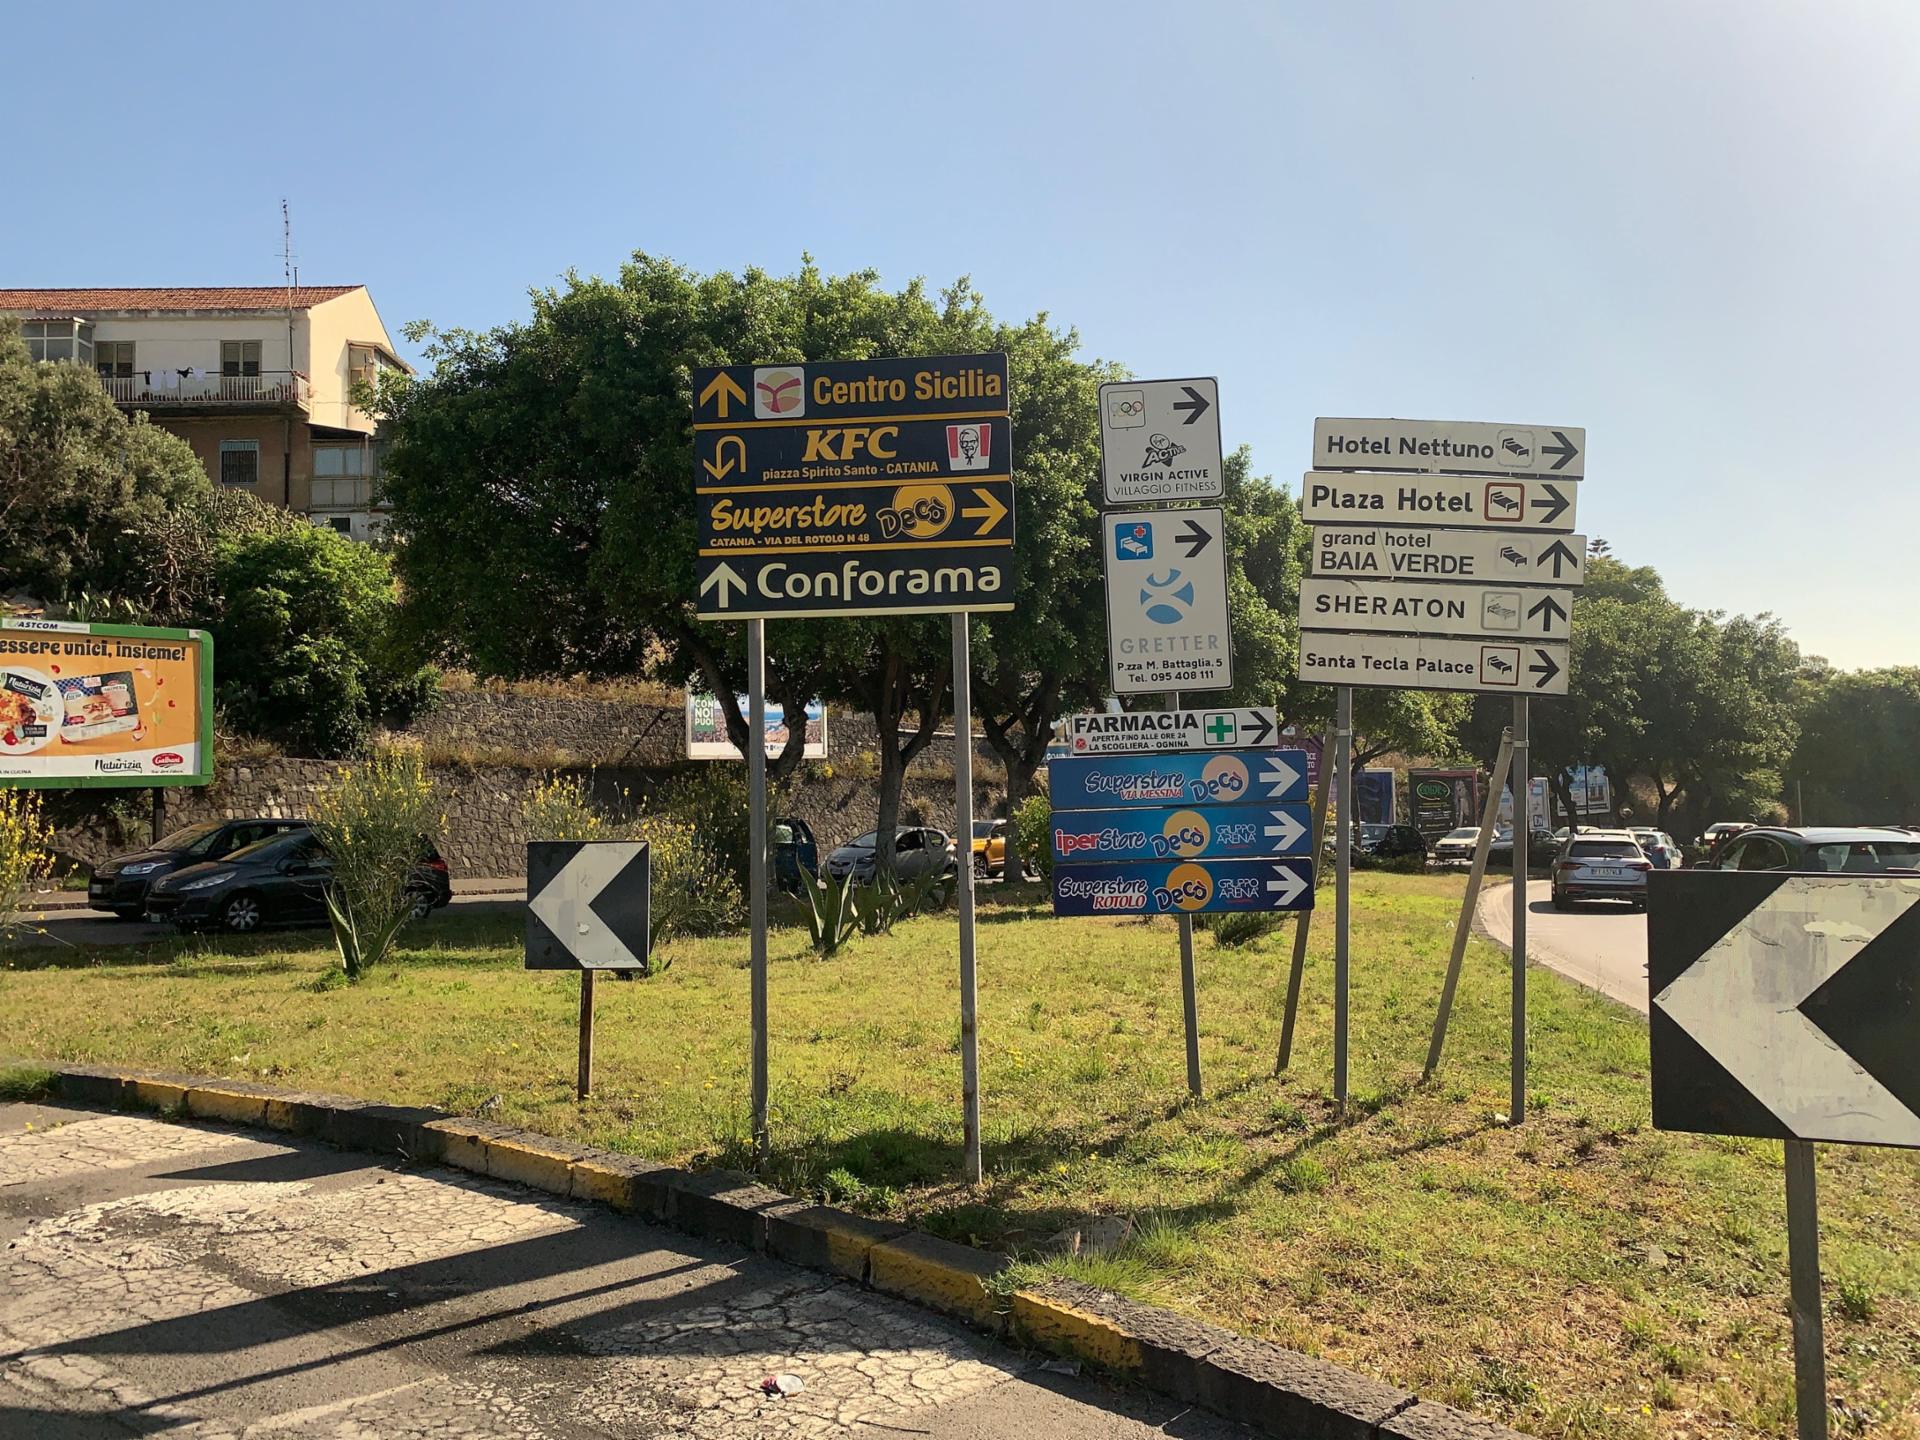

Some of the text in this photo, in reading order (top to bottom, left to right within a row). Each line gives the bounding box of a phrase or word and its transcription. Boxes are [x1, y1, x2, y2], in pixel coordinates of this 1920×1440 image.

[813, 368, 1001, 405] Centro Sicilia
[801, 426, 899, 462] KFC
[1327, 436, 1494, 459] Hotel Nettuno
[762, 467, 800, 481] piazza
[801, 465, 841, 480] Spirito
[843, 464, 877, 476] Santo
[886, 461, 938, 474] CATANIA
[1120, 469, 1209, 482] VIRGIN ACTIVE
[1113, 481, 1217, 496] VILLAGGIO FITNESS
[1311, 485, 1473, 512] Plaza Hotel
[710, 495, 867, 534] Superstore
[710, 536, 755, 546] CATANIA
[763, 536, 782, 545] VIA
[784, 535, 803, 545] DEL
[804, 534, 844, 544] ROTOLO
[846, 534, 856, 543] N
[857, 533, 870, 543] 48
[1322, 532, 1431, 548] grand hotel
[1320, 550, 1474, 575] BAIA VERDE
[757, 560, 1001, 601] Conforama
[1315, 594, 1465, 619] SHERATON
[64, 639, 112, 658] unici,
[116, 642, 186, 661] insieme!
[1120, 633, 1219, 654] GRETTER
[1215, 658, 1222, 667] 5
[1305, 653, 1474, 674] Santa Tecla Palace
[1128, 670, 1214, 683] Tel. 095 408 111
[694, 699, 714, 708] CON
[694, 708, 714, 718] NOI
[694, 717, 714, 726] PUOI
[1074, 713, 1199, 734] FARMACIA
[1088, 743, 1101, 751] LA
[1102, 741, 1149, 750] SCOGLIERA
[1156, 739, 1189, 748] OGNINA
[1091, 734, 1120, 742] APERTA
[1085, 769, 1185, 796] Superstore
[1120, 788, 1183, 800] VIA MESSINA
[1215, 824, 1256, 834] GRUPPO
[1216, 833, 1256, 845] ARENA
[1058, 877, 1148, 900] Superstore
[1218, 878, 1259, 888] GRUPPO
[1219, 887, 1259, 899] ARENA
[1092, 895, 1147, 909] ROTOLO
